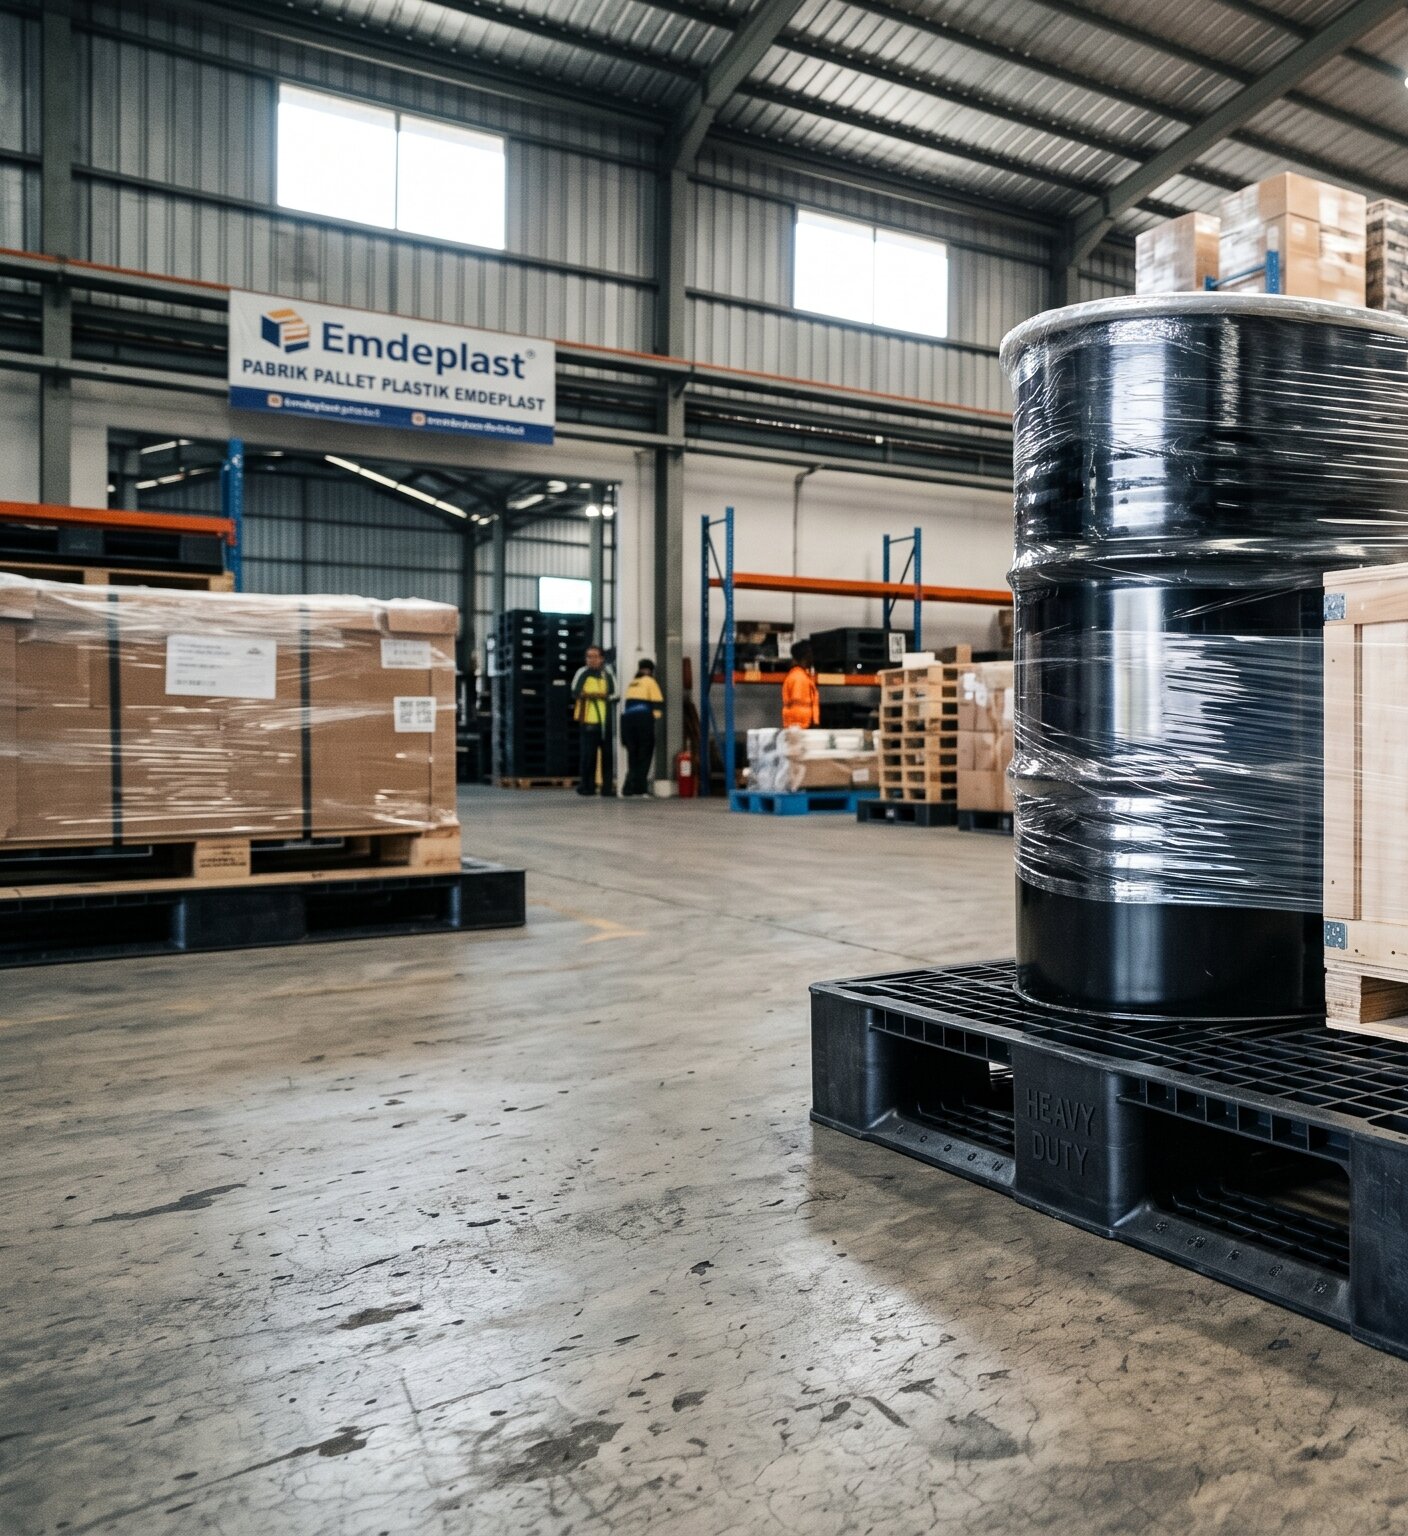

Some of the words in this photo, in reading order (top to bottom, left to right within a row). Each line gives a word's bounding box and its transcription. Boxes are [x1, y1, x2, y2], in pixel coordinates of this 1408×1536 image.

[242, 358, 308, 381] PABRIK
[314, 367, 376, 390] PALLET
[382, 377, 450, 400] PLASTIK
[455, 387, 546, 412] EMDEPLAST
[1026, 1087, 1096, 1137] HEAVY
[1032, 1129, 1088, 1177] DUTY
